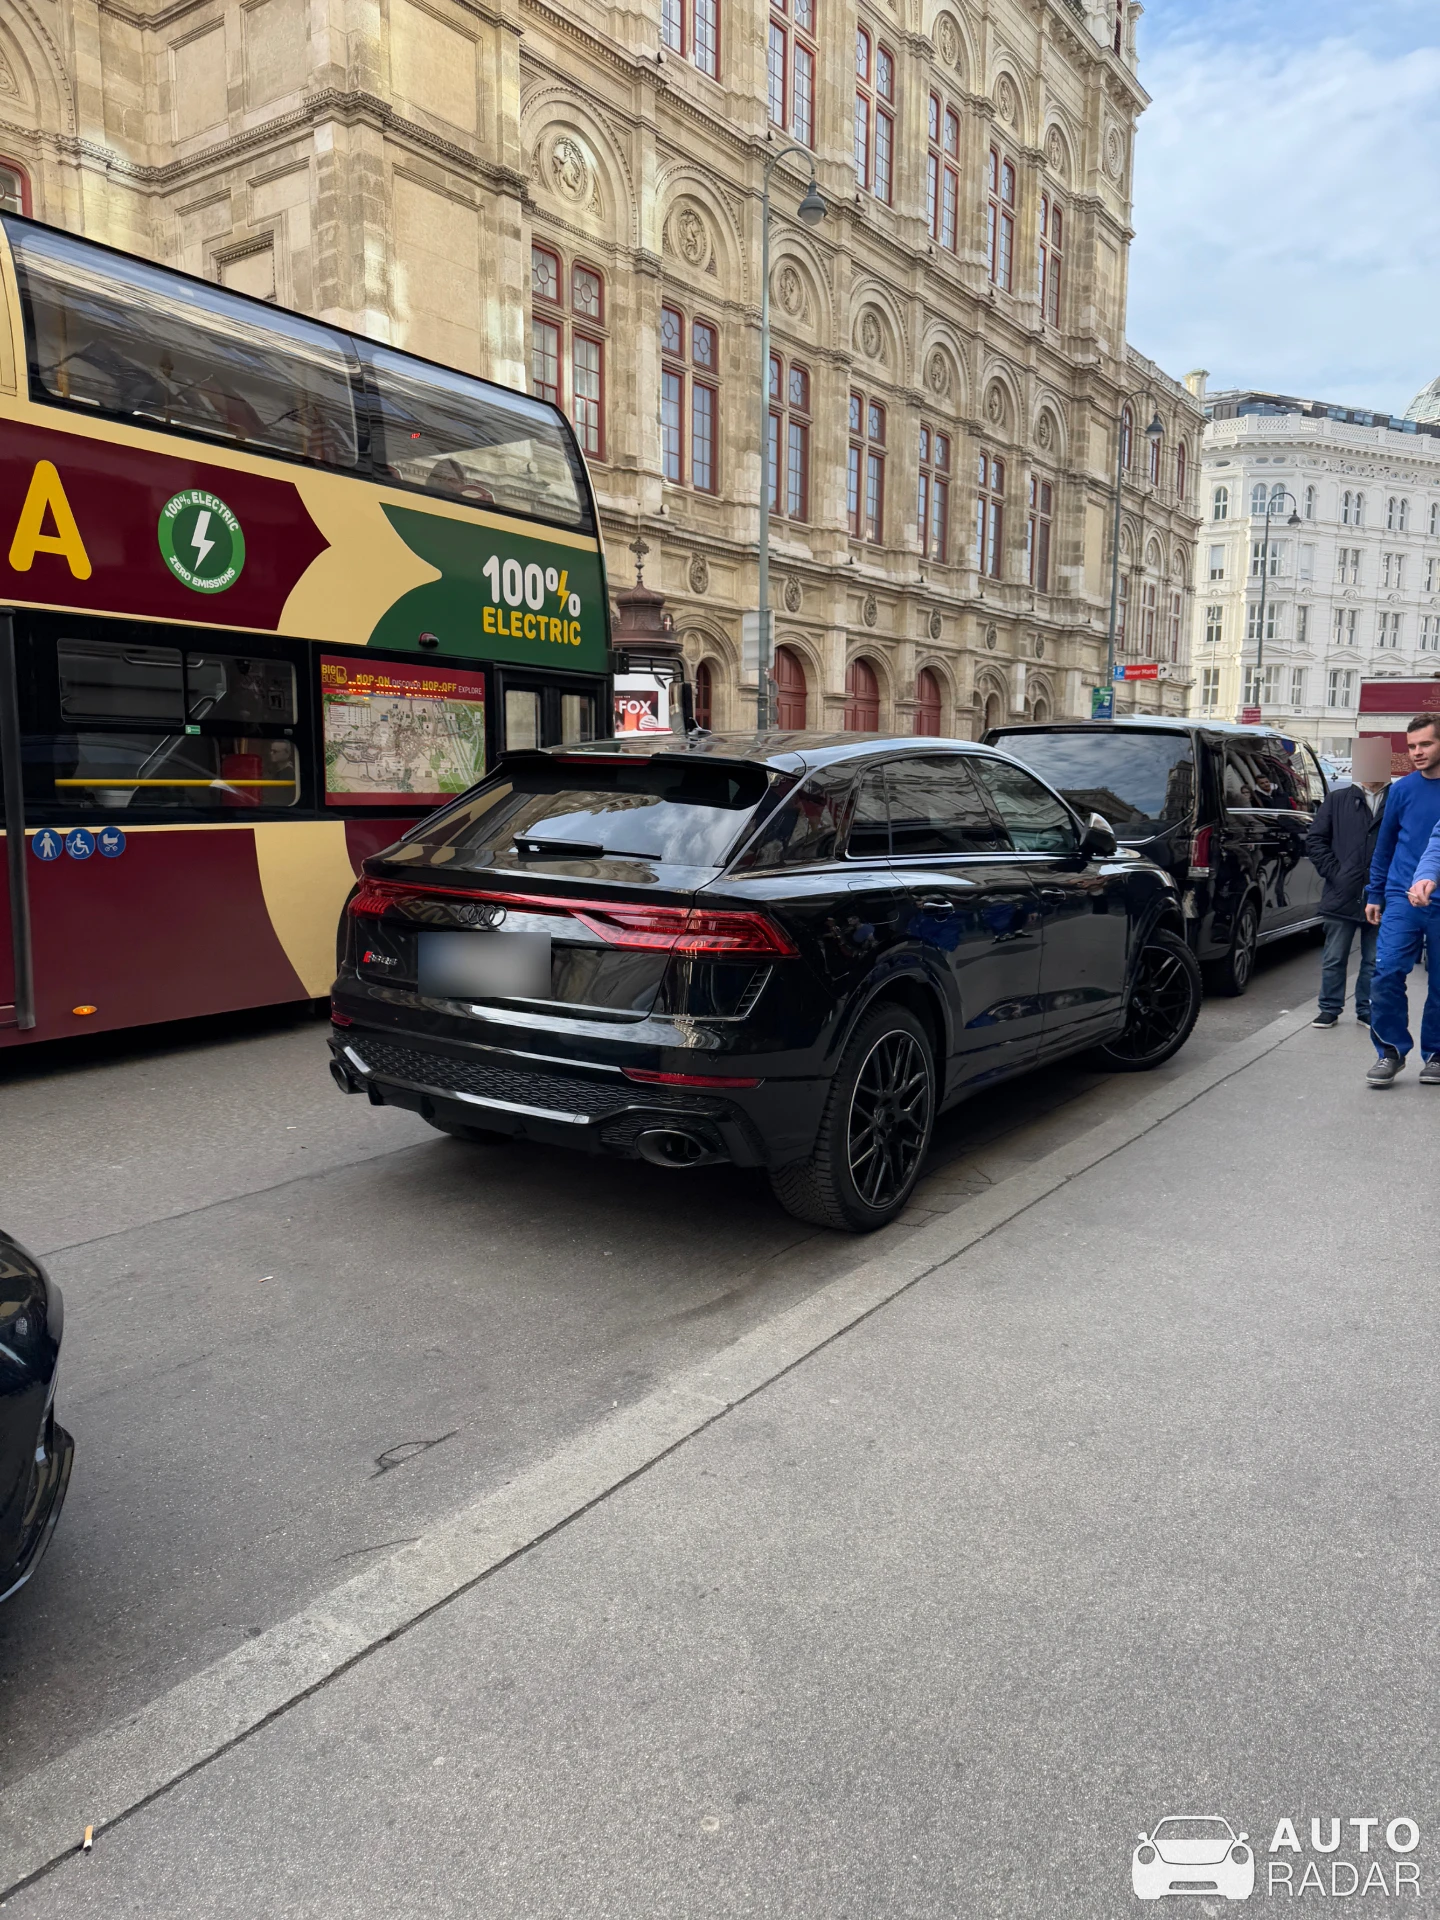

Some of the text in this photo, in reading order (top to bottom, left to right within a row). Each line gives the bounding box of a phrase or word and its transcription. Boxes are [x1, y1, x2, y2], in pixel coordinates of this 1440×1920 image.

[9, 460, 92, 580] A
[164, 491, 239, 531] 100% ELECTRIC
[169, 555, 235, 588] ZERO EMISSIONS
[482, 555, 581, 617] 100%
[482, 606, 581, 645] ELECTRIC
[321, 664, 336, 675] BIG
[321, 673, 337, 684] BUS
[1141, 667, 1157, 675] Markt
[422, 679, 457, 692] HOP-OFF
[458, 686, 482, 695] EXPLORE
[618, 700, 651, 714] FOX
